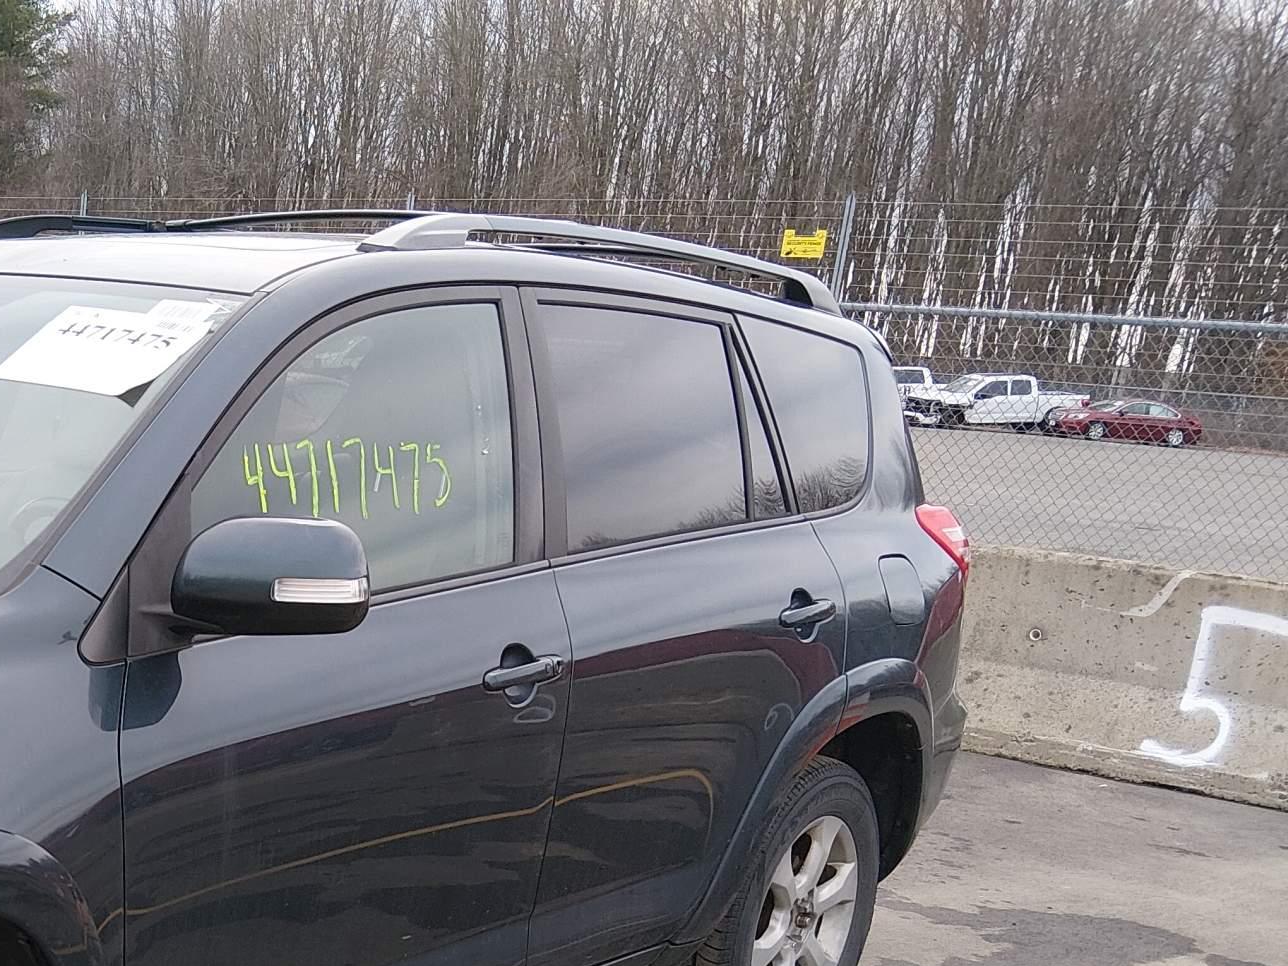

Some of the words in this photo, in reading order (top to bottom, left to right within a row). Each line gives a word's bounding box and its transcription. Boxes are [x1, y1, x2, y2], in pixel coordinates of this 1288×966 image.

[58, 322, 178, 349] 44717475
[242, 437, 452, 519] 44717475
[1139, 605, 1288, 767] 5
